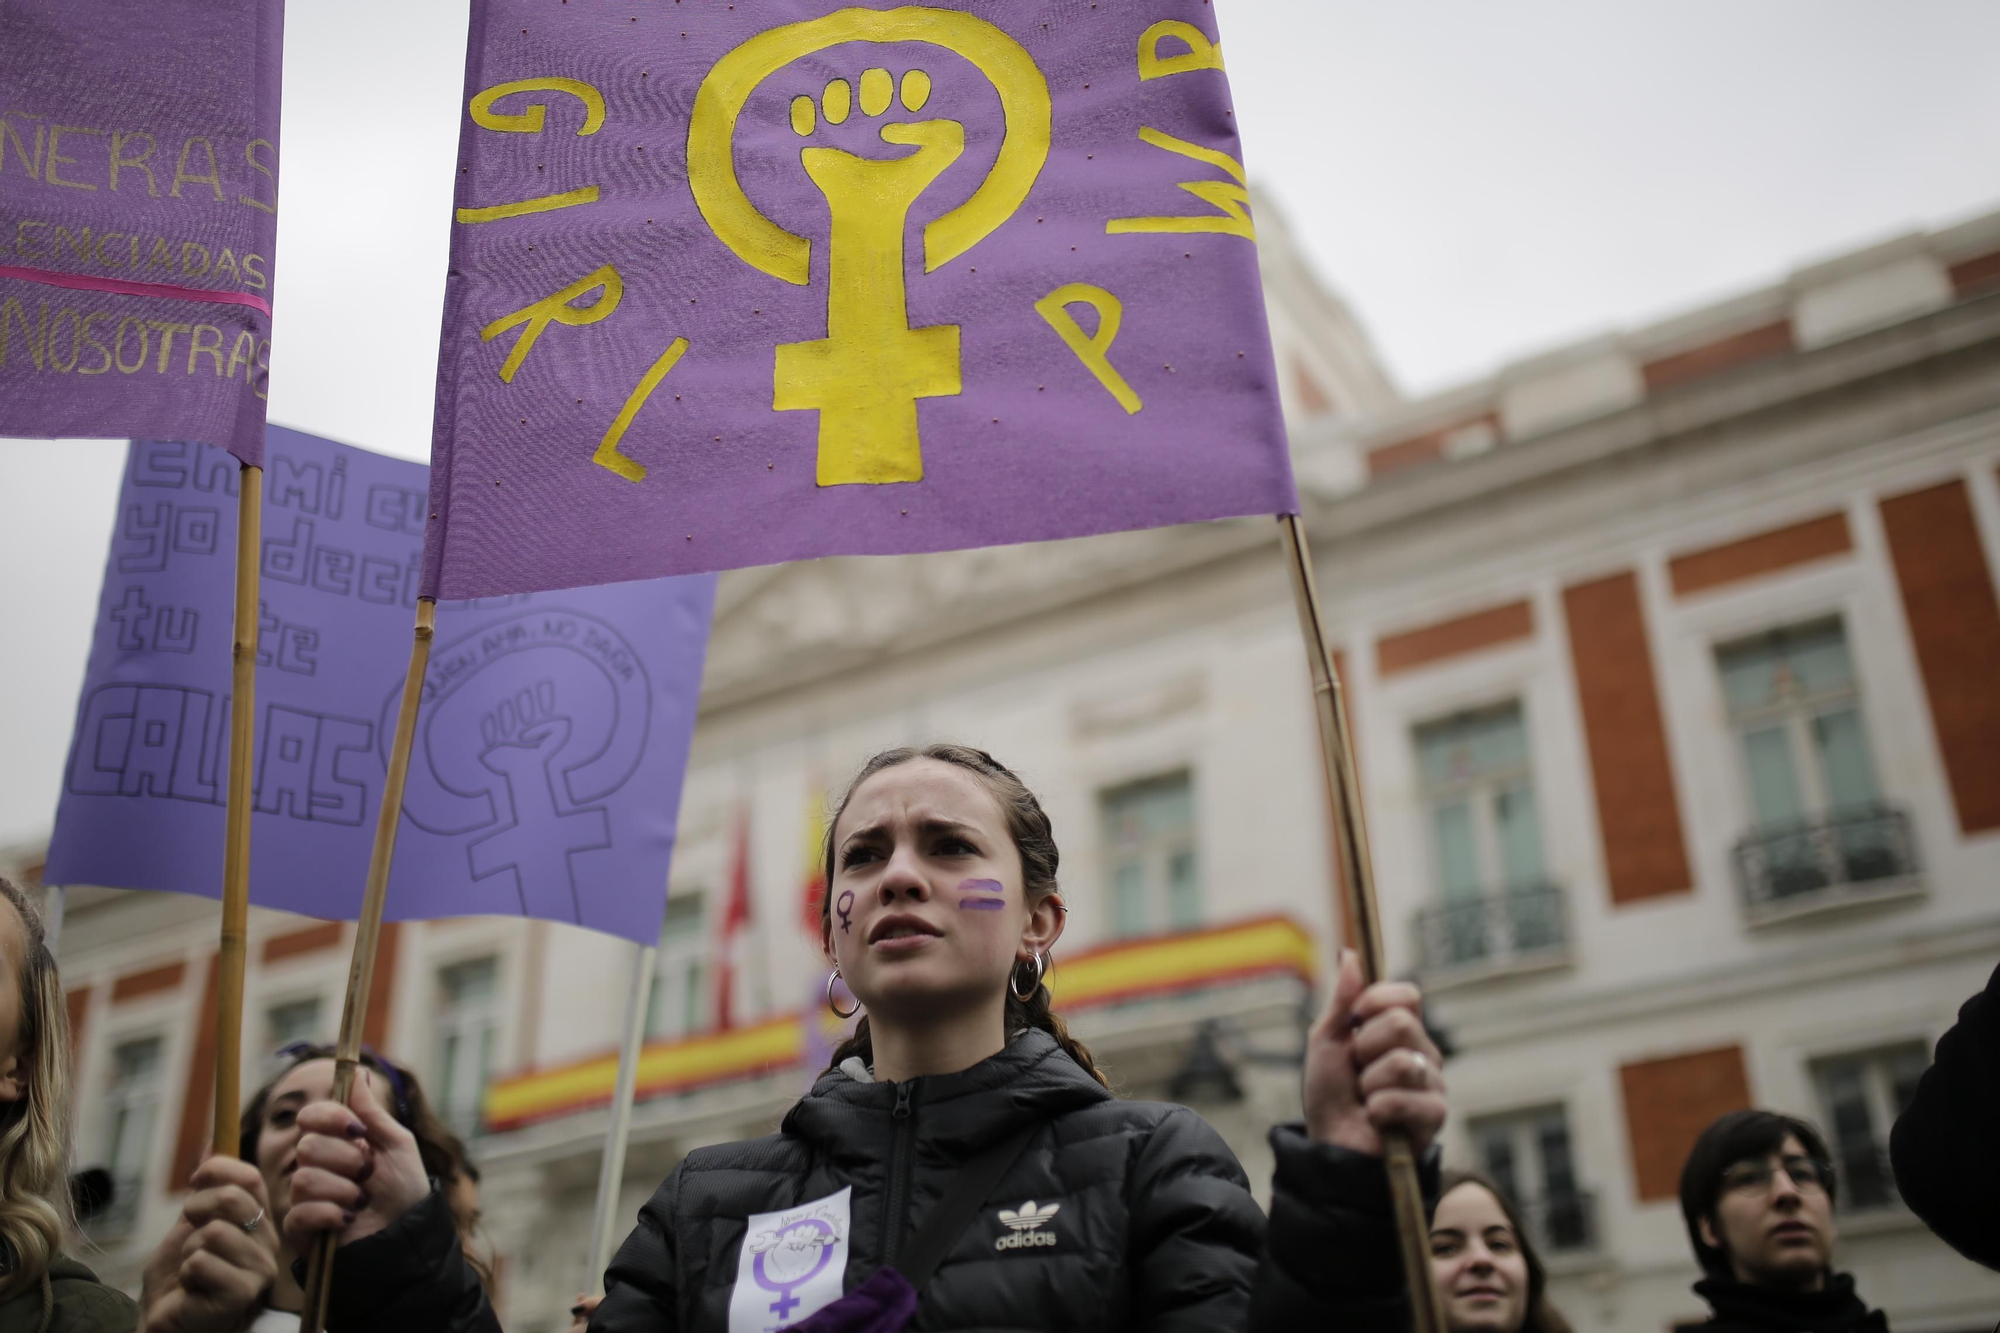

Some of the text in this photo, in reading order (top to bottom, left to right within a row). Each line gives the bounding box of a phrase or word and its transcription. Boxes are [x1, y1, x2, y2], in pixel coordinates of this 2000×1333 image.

[0, 221, 267, 290] ENCIADAS
[456, 76, 690, 483] GIRL
[118, 500, 219, 575] yo
[110, 585, 199, 655] tu
[543, 618, 578, 641] NO
[995, 1231, 1057, 1251] adidas
